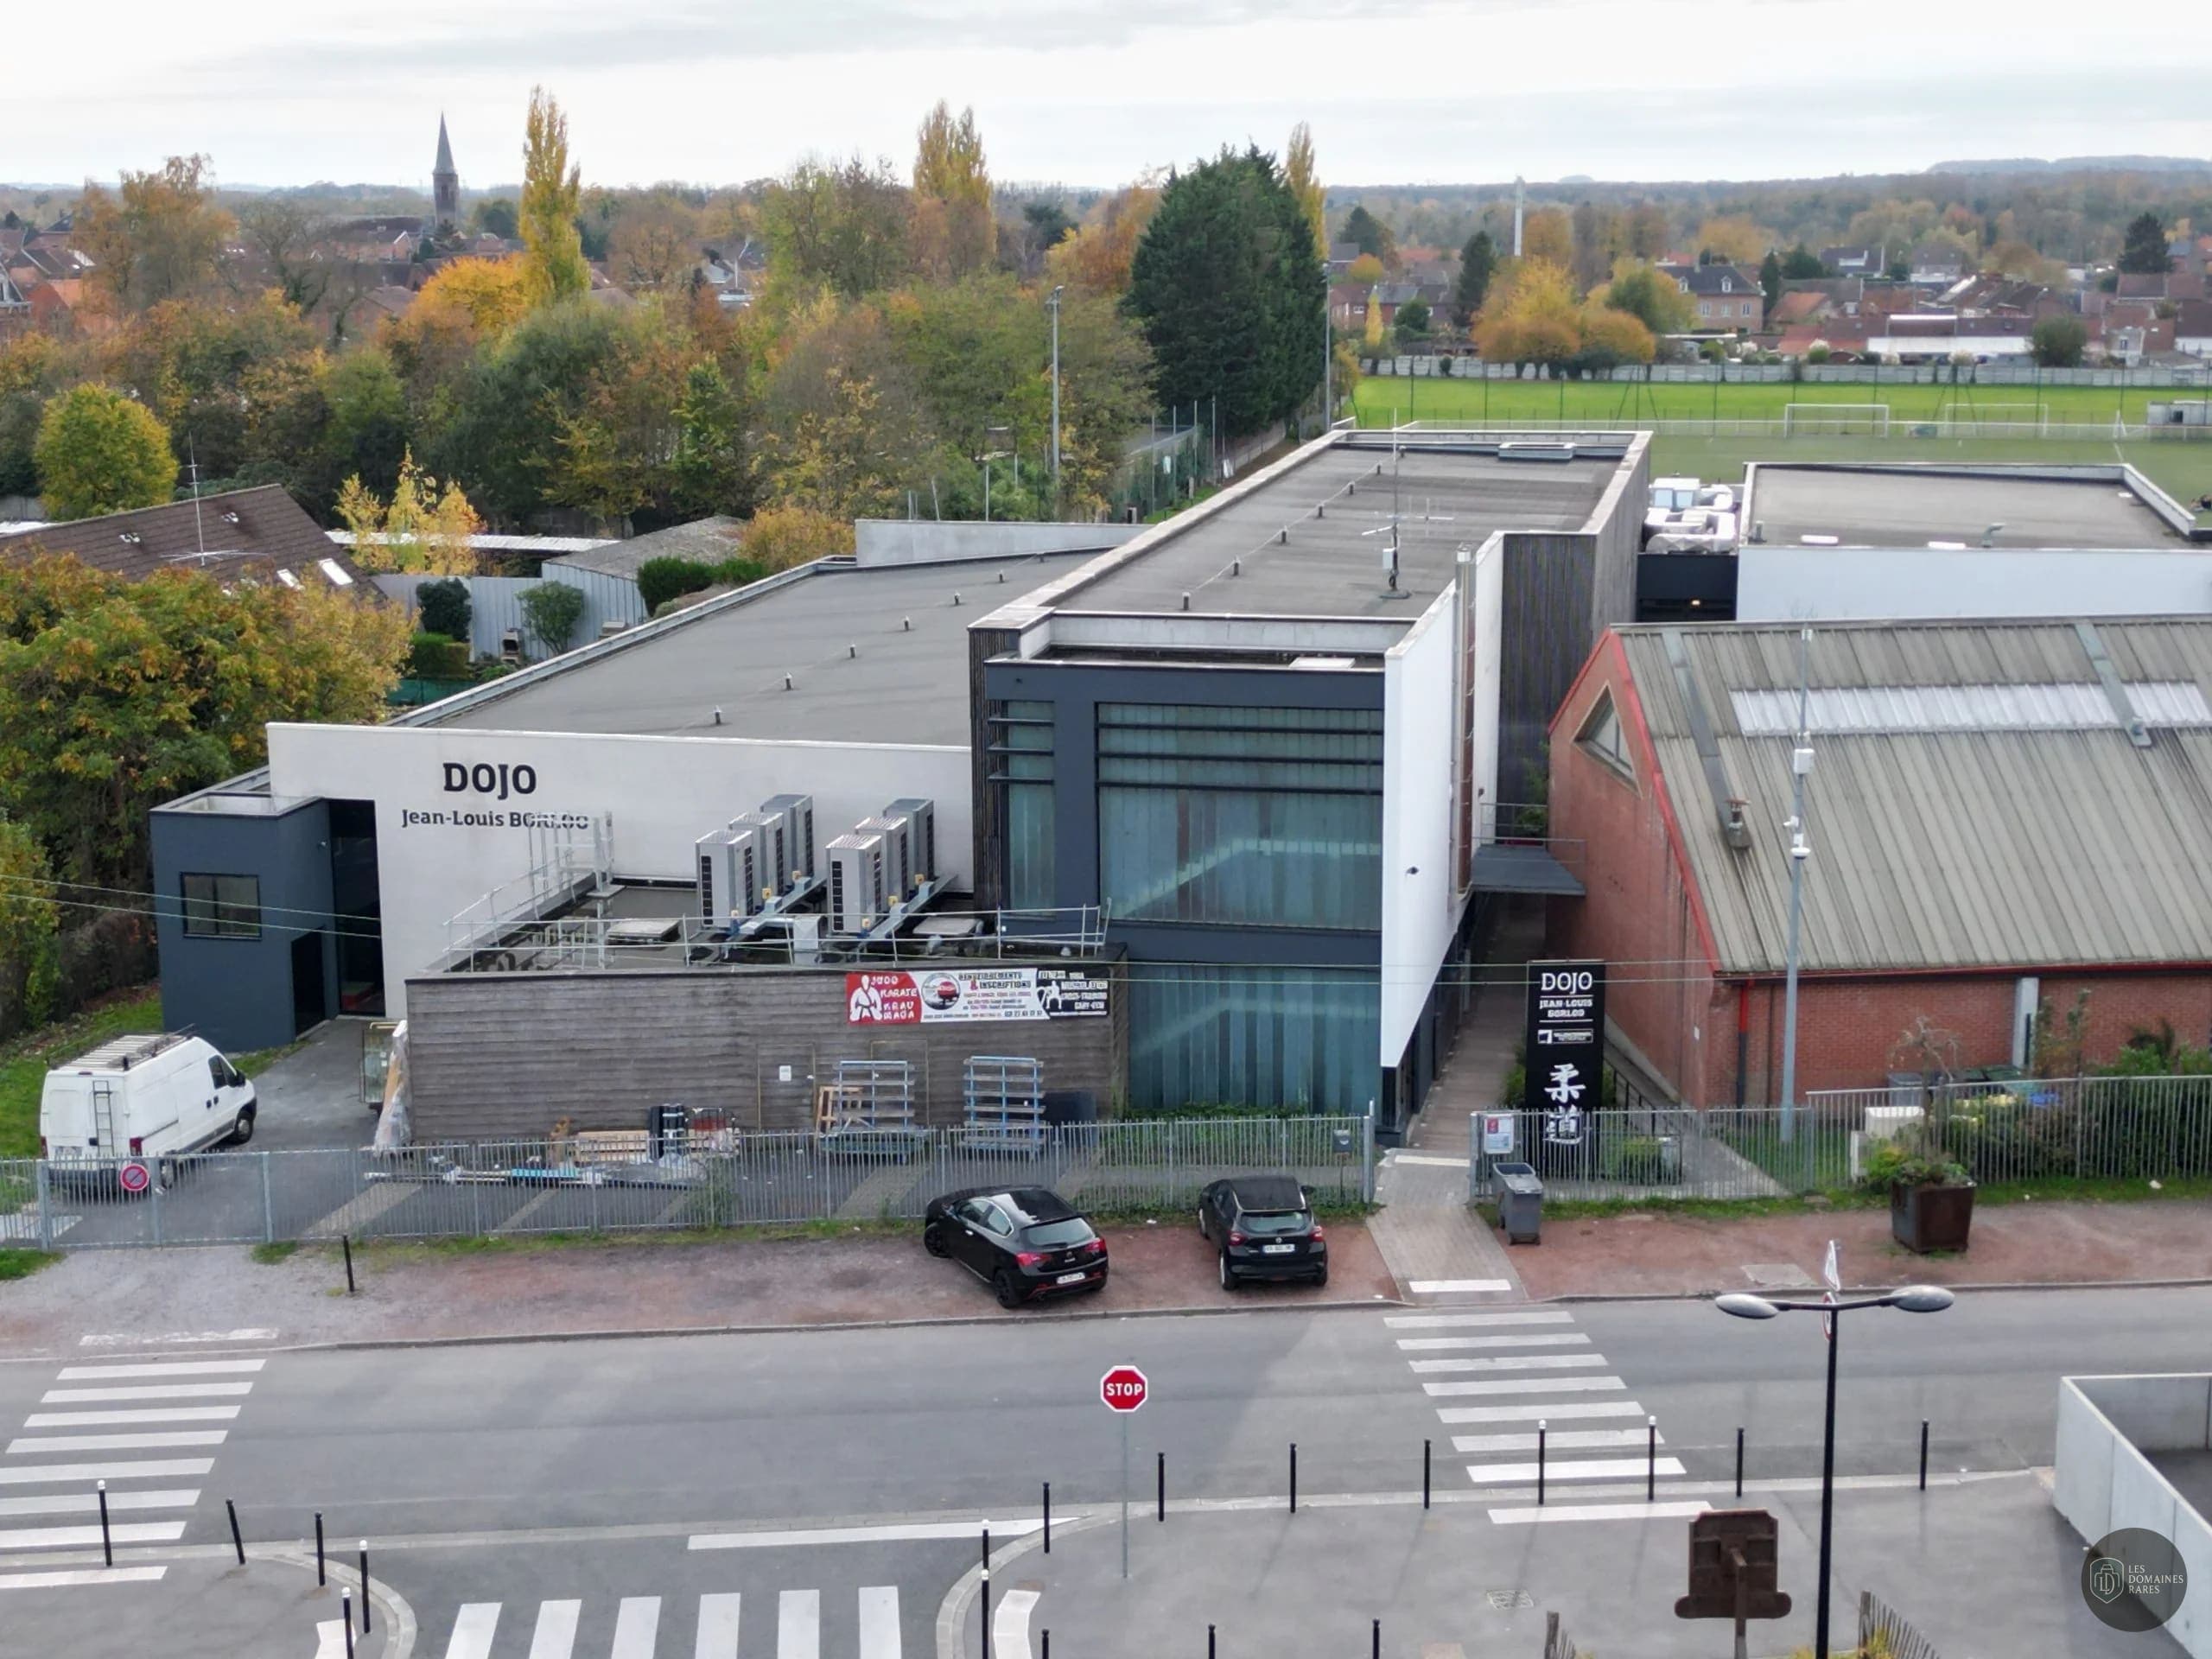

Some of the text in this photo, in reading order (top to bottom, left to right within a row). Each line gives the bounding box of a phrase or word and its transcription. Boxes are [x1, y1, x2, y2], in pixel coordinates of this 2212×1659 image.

[443, 762, 536, 800] DOJO
[403, 810, 504, 828] Jean-Louis
[870, 976, 898, 985] JUDO
[1541, 972, 1592, 994] DOJO
[880, 988, 918, 997] KARATE
[1107, 1382, 1142, 1396] STOP
